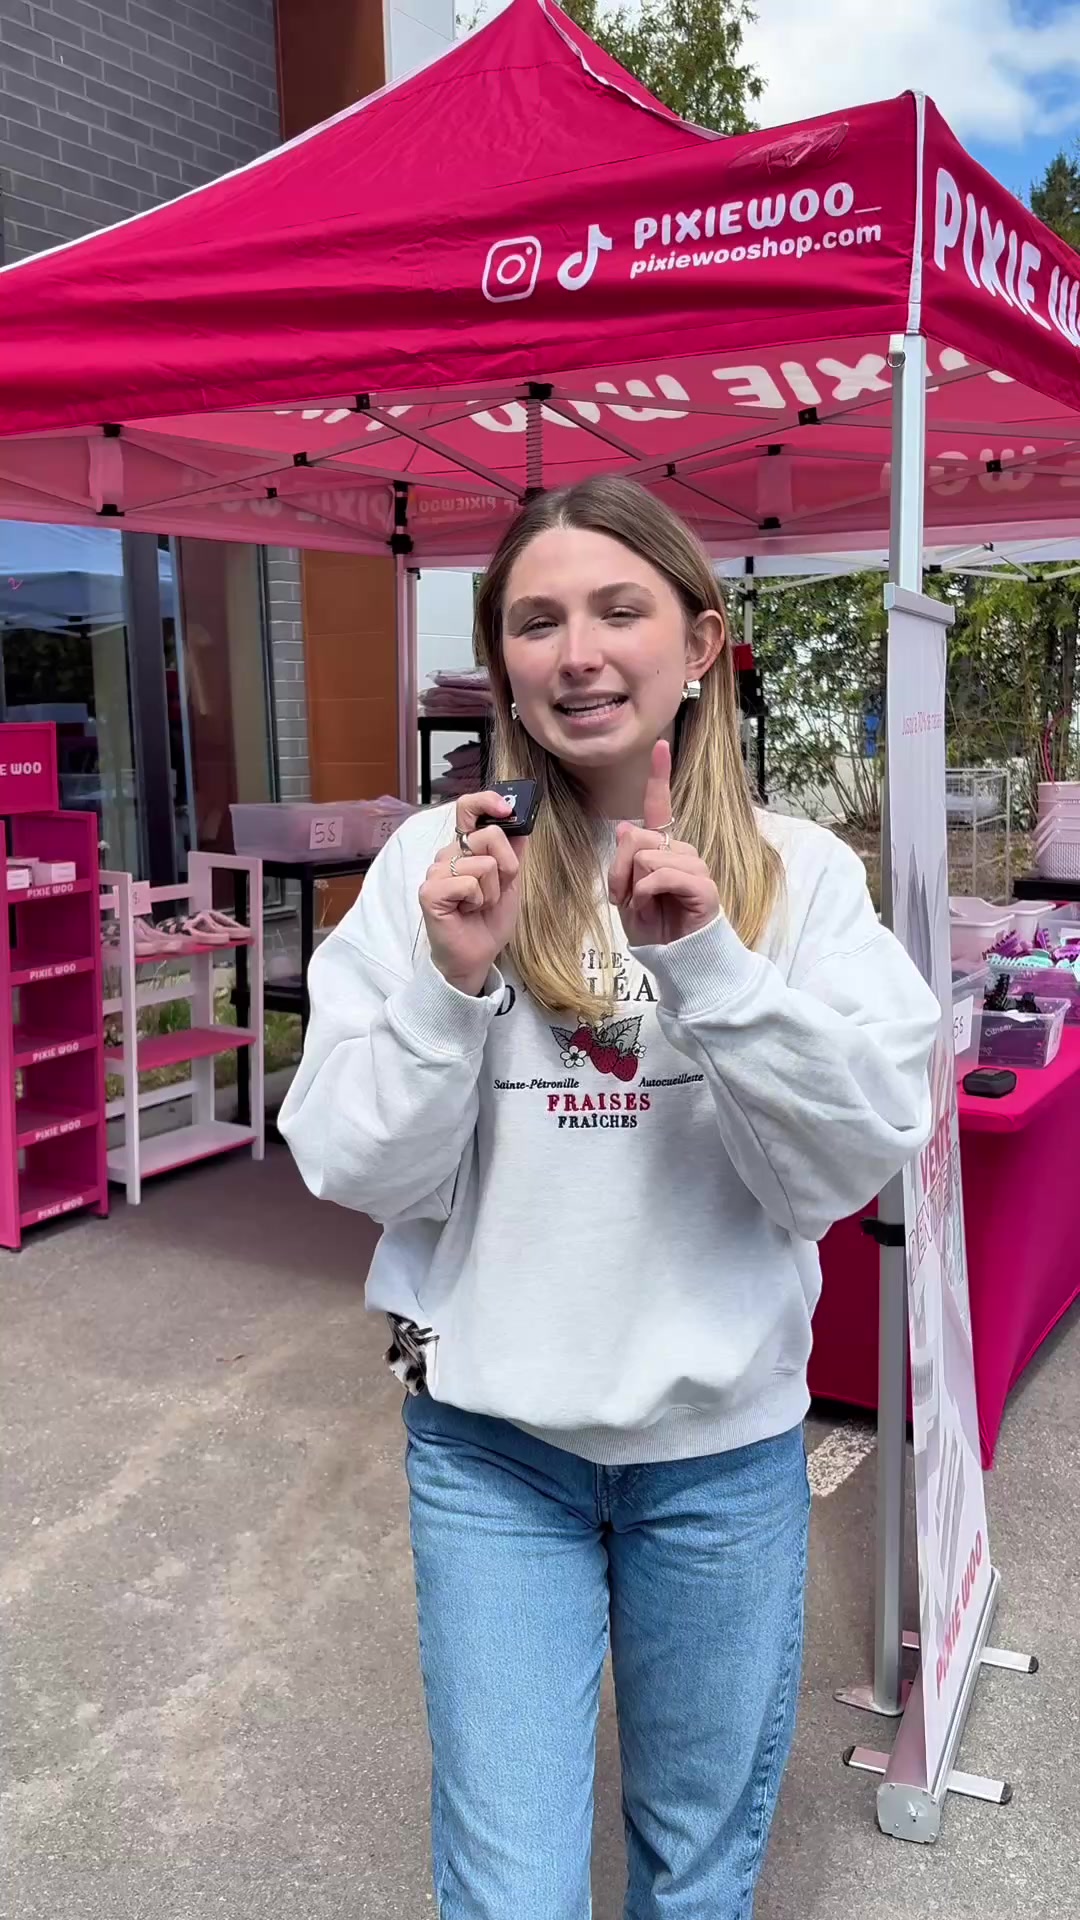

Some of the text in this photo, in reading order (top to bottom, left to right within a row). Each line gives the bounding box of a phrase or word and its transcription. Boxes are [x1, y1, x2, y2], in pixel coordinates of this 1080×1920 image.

[629, 224, 882, 280] pixiewooshop.com
[933, 167, 1052, 331] PIXIE
[10, 761, 42, 775] WOO
[27, 883, 74, 898] PIXIE WOO
[30, 963, 76, 980] PIXIE WOO
[32, 1042, 79, 1063] PIXIE WOO
[493, 1072, 704, 1090] Sainte-Pétronille Autocueillette
[547, 1092, 651, 1112] FRAISES
[35, 1119, 81, 1141] PIXIE WOO
[558, 1113, 638, 1128] FRAÎCHES
[37, 1196, 84, 1220] PIXIE WOO
[961, 1529, 982, 1610] WOO
